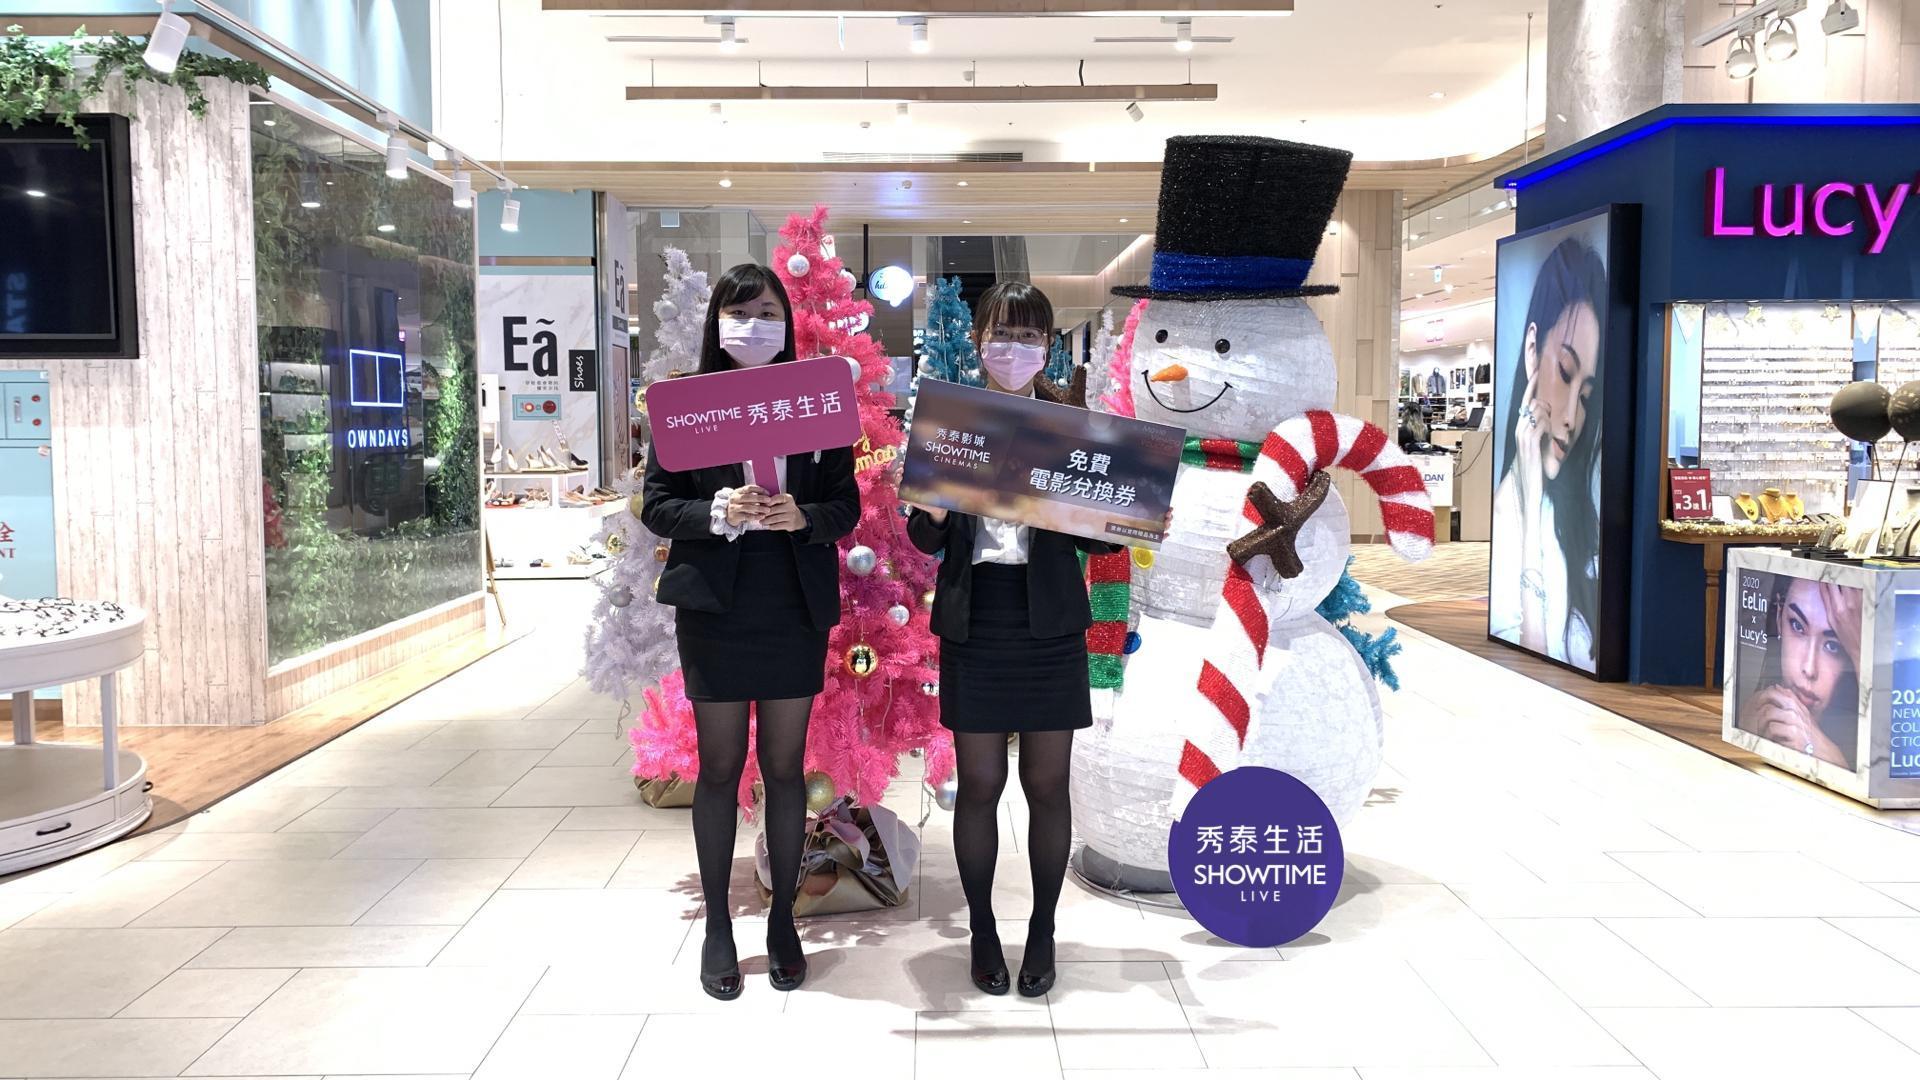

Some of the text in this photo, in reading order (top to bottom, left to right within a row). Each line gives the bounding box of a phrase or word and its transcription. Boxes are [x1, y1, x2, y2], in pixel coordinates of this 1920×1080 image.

[1704, 166, 1920, 255] Lucy
[574, 355, 584, 388] Shoes
[666, 390, 842, 429] SHOWTIME 秀泰生活
[347, 428, 409, 448] OWNDAYS
[694, 424, 719, 434] LIVE
[935, 427, 986, 448] 秀泰影城
[925, 440, 991, 464] SHOWTIME
[933, 454, 978, 470] CINEMAS
[1066, 448, 1111, 476] 免費
[1029, 467, 1137, 508] 電影兌換券
[1423, 473, 1444, 481] DAN
[1742, 575, 1760, 589] 2020
[1742, 590, 1768, 613] EeLin
[1740, 624, 1768, 645] Lucy's
[1196, 824, 1324, 854] 秀泰生活
[1194, 864, 1327, 885] SHOWTIME
[1240, 890, 1281, 902] LIVE
